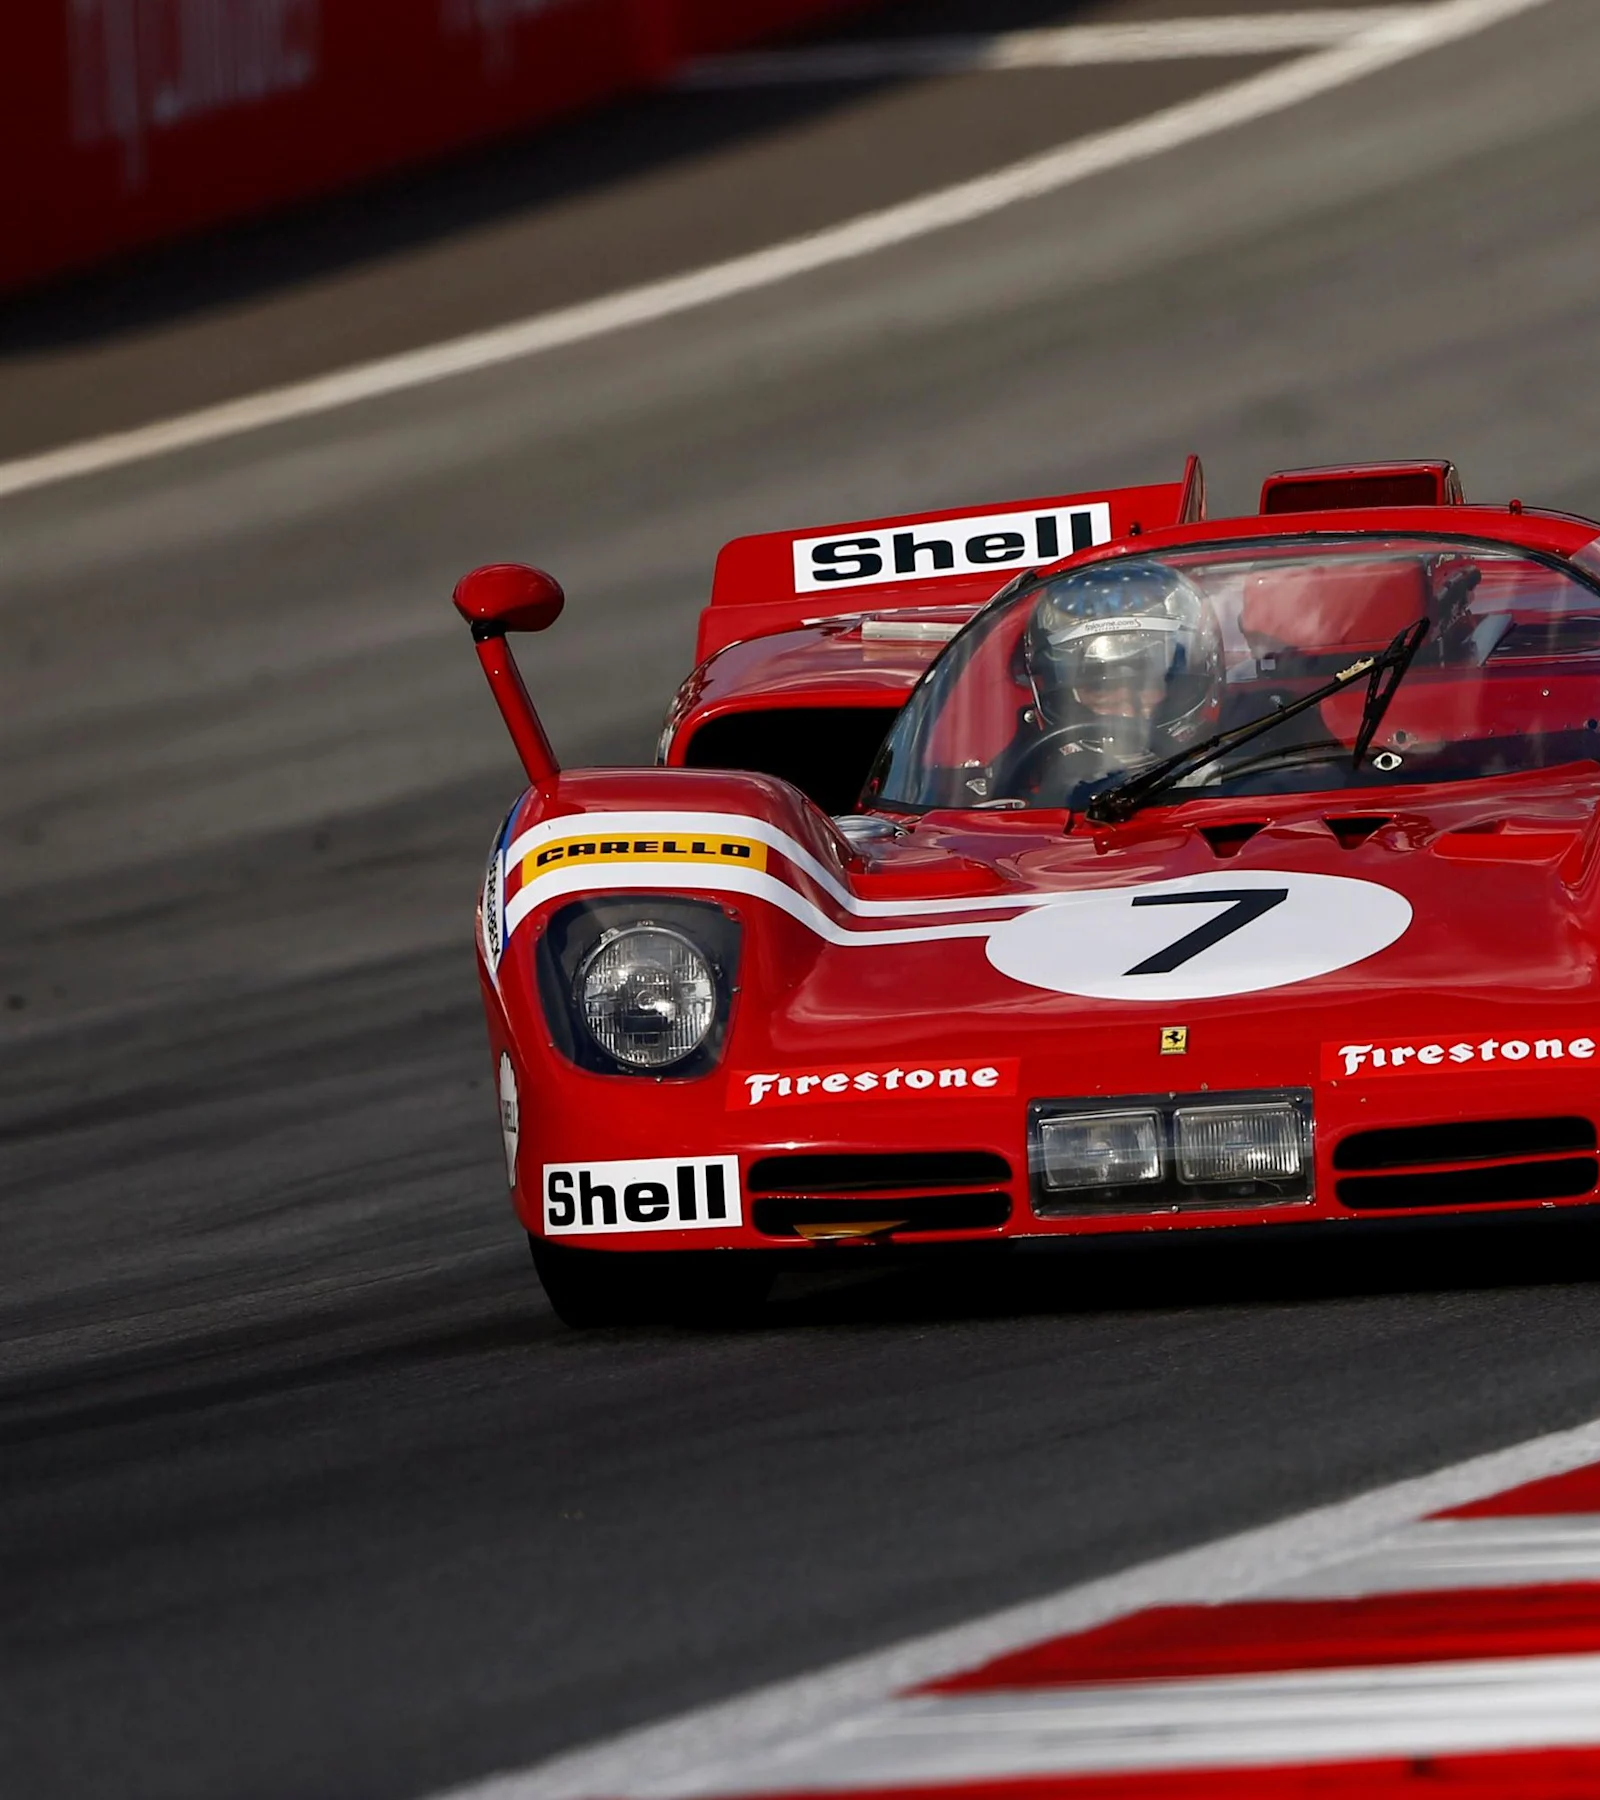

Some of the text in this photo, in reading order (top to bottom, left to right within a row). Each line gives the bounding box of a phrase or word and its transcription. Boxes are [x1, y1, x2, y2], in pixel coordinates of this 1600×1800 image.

[812, 512, 1093, 582] Shell
[537, 841, 751, 867] CARELLO
[1123, 888, 1289, 976] 7
[1338, 1038, 1595, 1076] Firestone
[744, 1067, 999, 1105] Firestone
[548, 1164, 728, 1228] Shell
